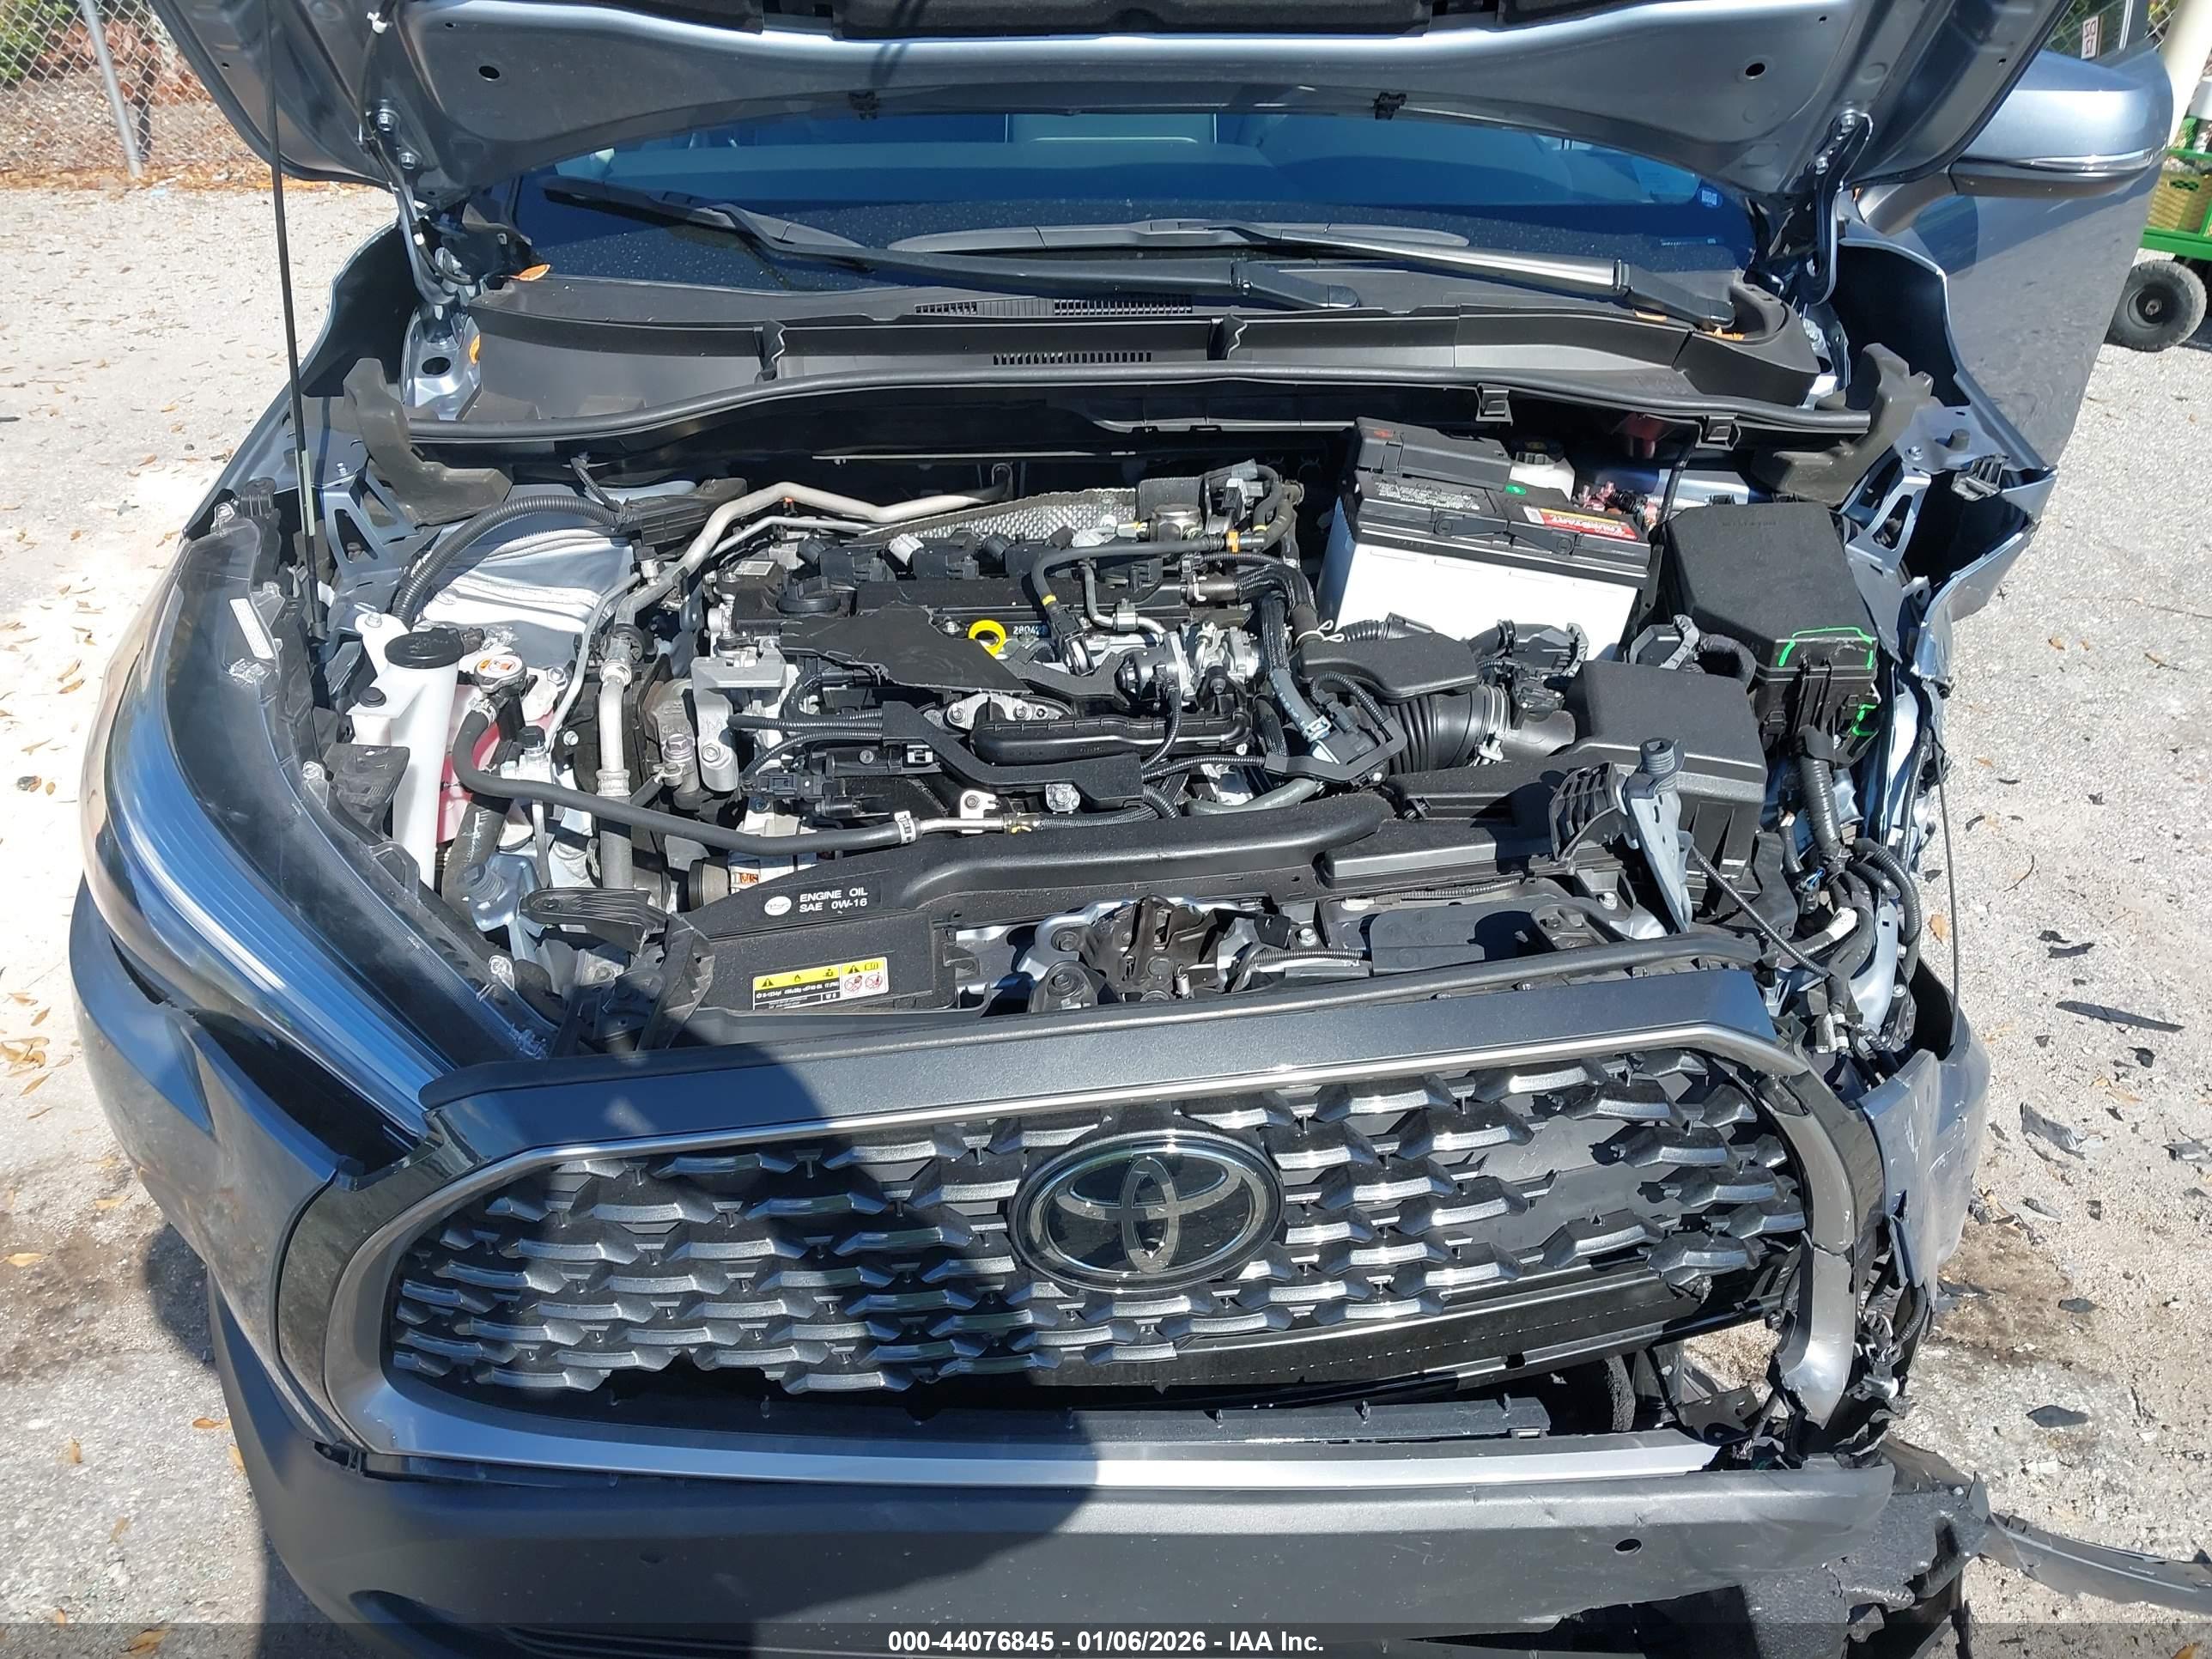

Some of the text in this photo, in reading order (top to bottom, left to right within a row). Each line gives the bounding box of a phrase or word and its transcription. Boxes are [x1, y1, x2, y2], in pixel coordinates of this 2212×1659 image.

[799, 887, 868, 902] ENGINE OIL
[799, 902, 823, 913] SAE
[830, 898, 868, 909] 0W-16
